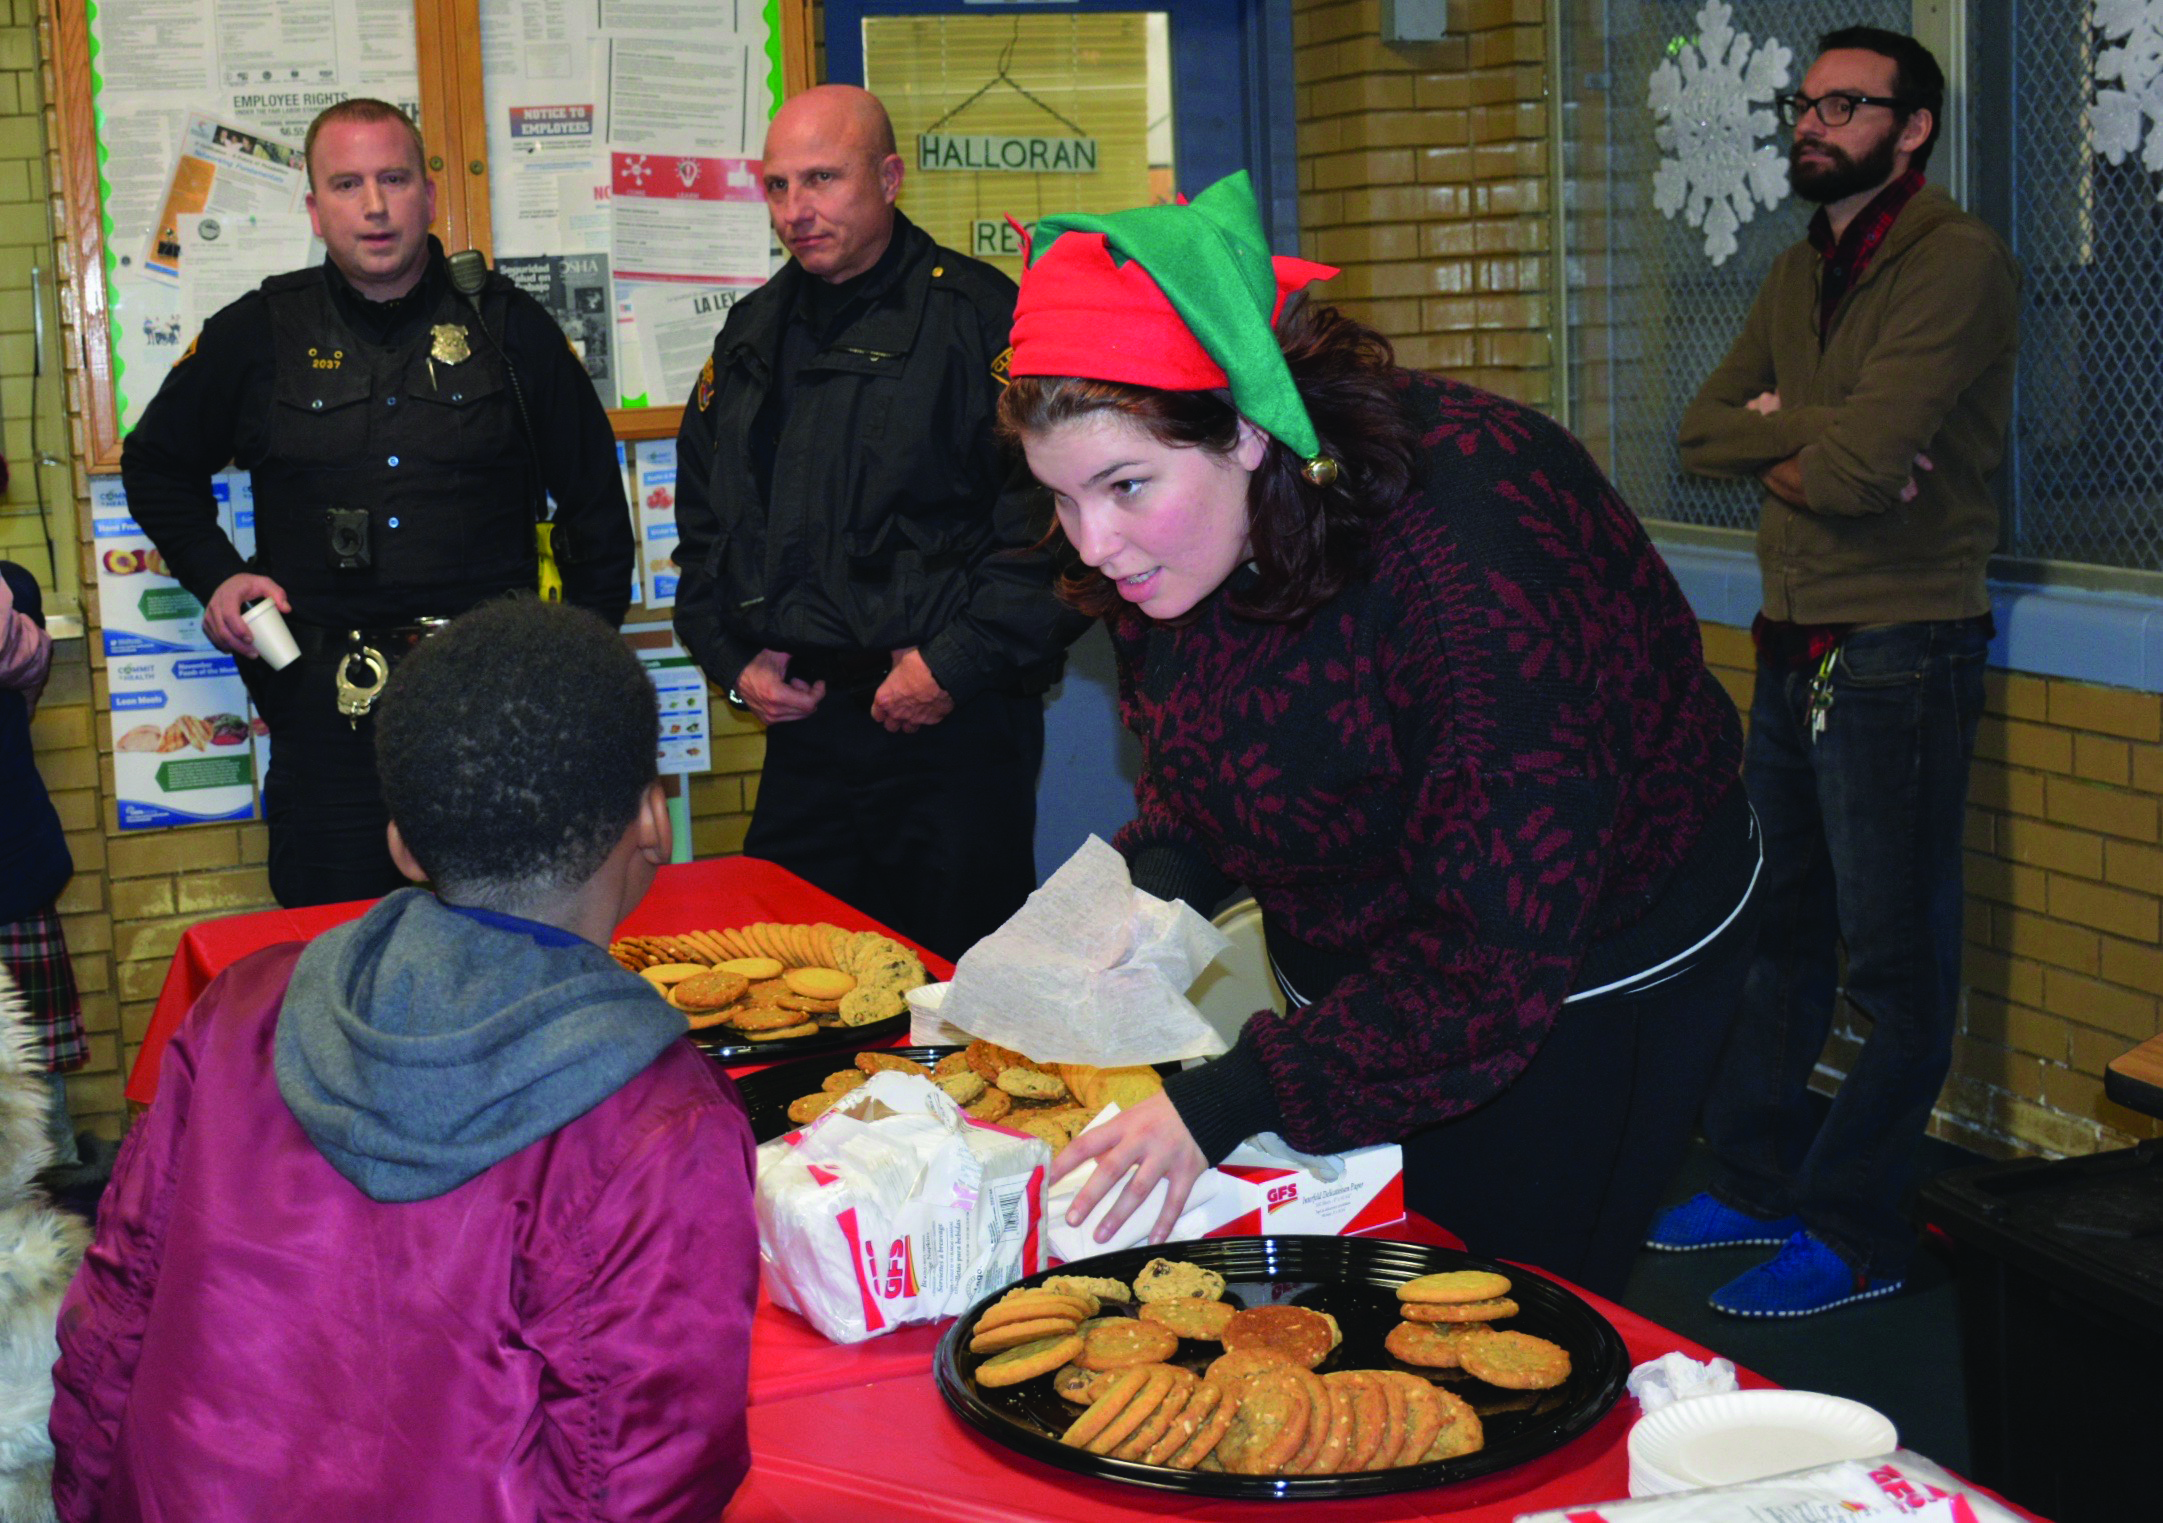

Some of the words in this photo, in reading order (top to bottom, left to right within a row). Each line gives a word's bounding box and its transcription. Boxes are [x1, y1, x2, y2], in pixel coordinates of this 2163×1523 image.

[233, 94, 300, 108] EMPLOYEE
[303, 91, 349, 106] RIGHTS
[523, 108, 566, 121] NOTICE
[570, 107, 586, 119] TO
[521, 121, 590, 135] EMPLOYEES
[921, 135, 1096, 170] HALLORAN
[500, 262, 550, 278] Seguridad
[694, 296, 712, 315] LA
[714, 291, 738, 311] LEY
[312, 359, 341, 369] 2037
[117, 664, 155, 675] COMMIT
[1267, 1182, 1298, 1203] GFS
[953, 1218, 961, 1245] bebidas
[955, 1246, 963, 1262] para
